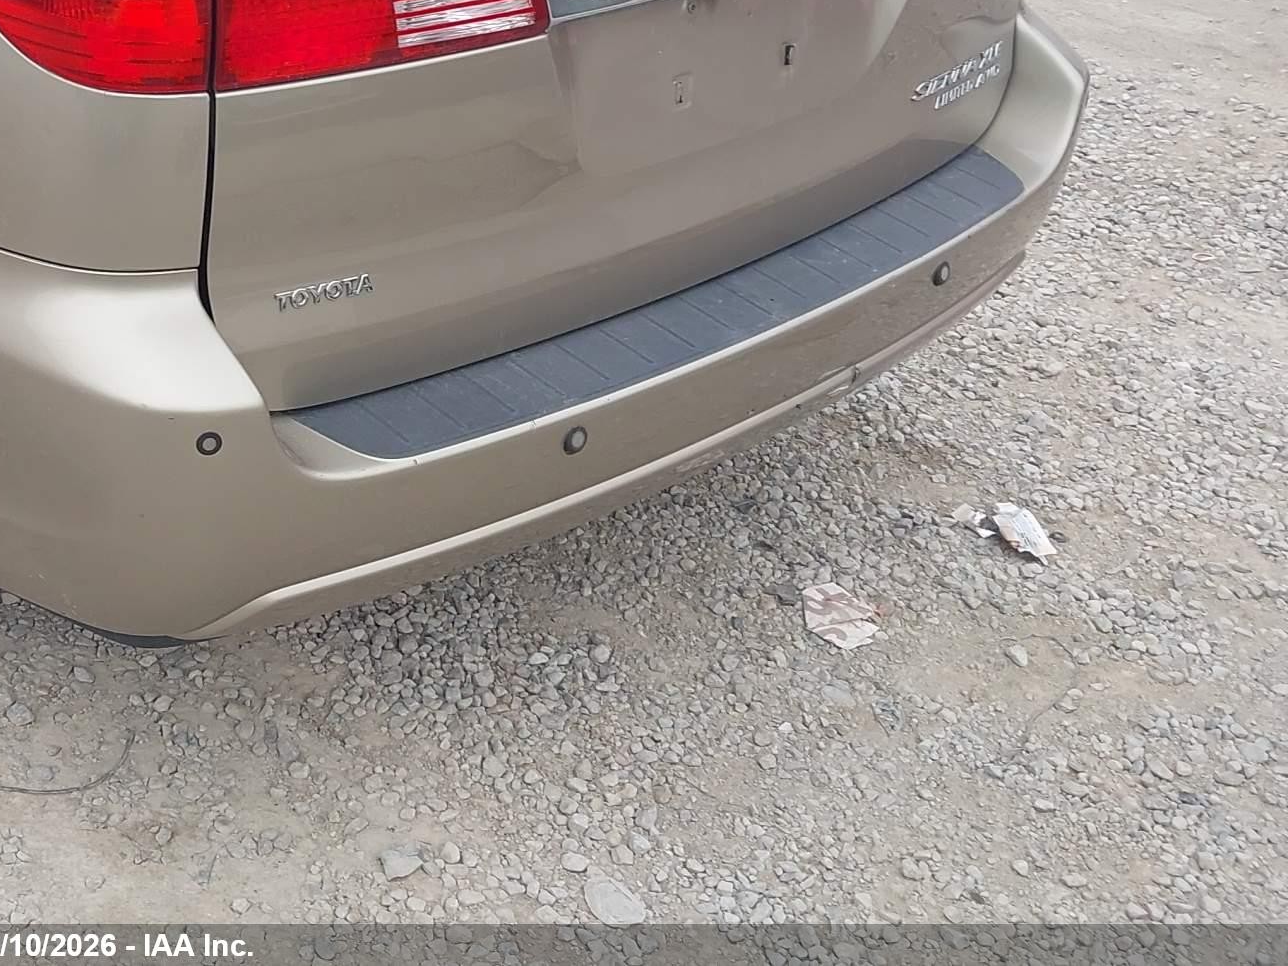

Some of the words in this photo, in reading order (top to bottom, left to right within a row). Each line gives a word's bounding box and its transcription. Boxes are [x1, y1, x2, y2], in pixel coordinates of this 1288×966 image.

[910, 58, 977, 102] SIENNA
[976, 40, 1004, 69] XLE
[274, 272, 374, 312] TOYOTA
